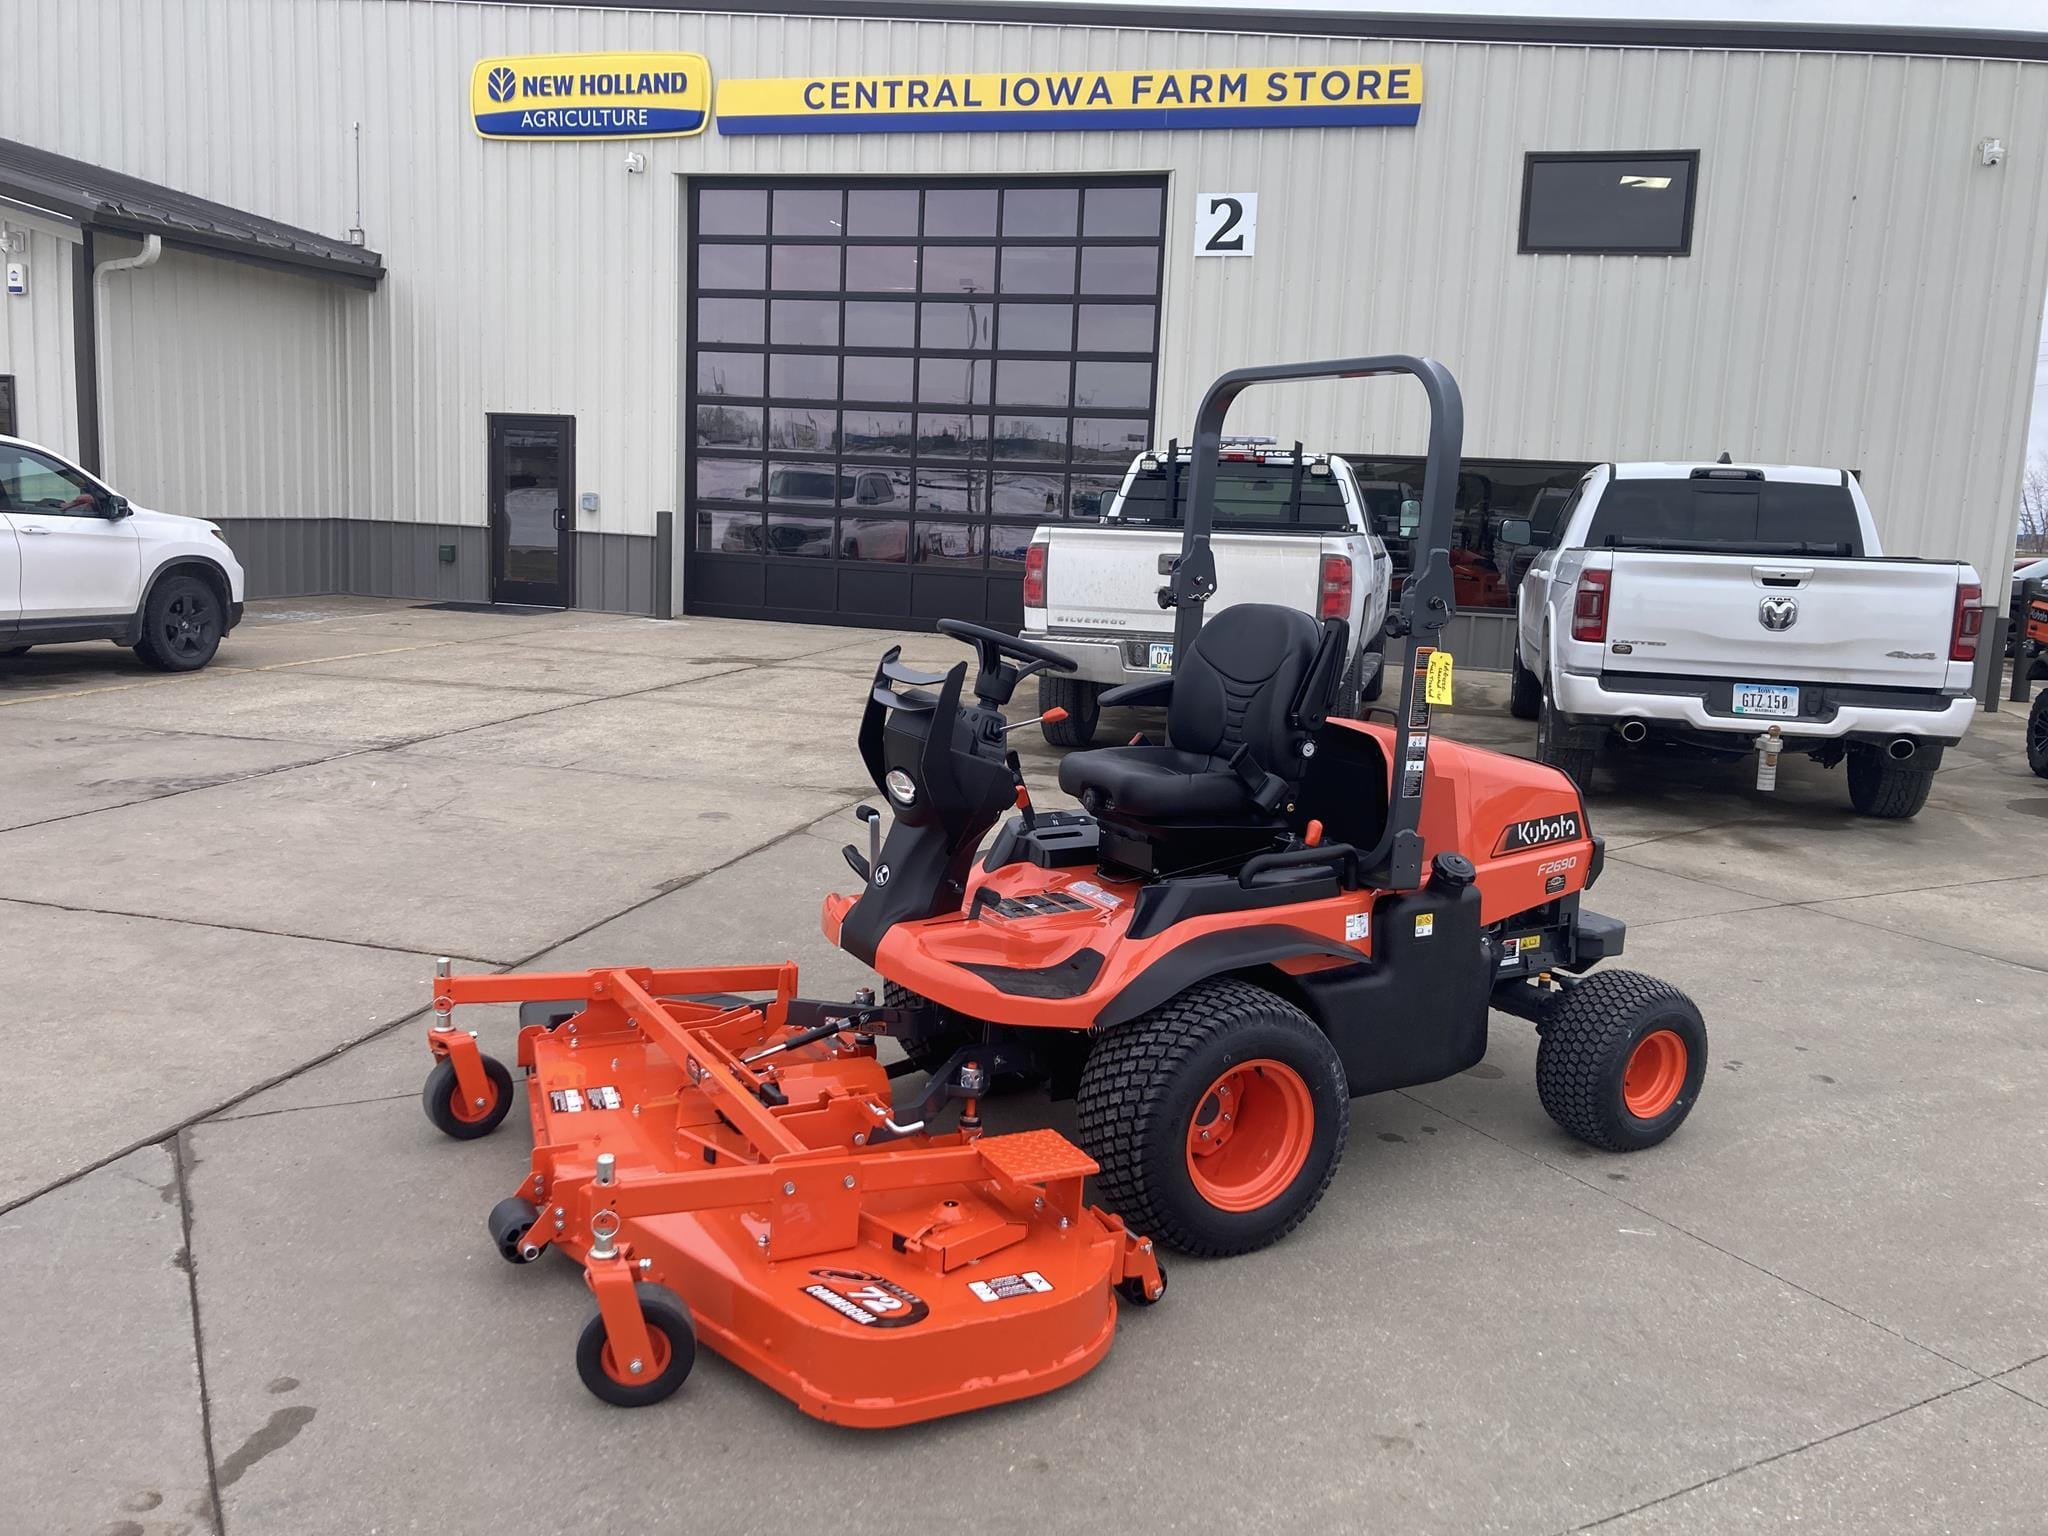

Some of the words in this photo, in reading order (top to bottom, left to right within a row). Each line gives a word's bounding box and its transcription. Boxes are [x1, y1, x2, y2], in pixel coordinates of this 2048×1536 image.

[522, 74, 574, 98] NEW
[579, 71, 688, 96] HOLLAND
[804, 79, 983, 110] CENTRAL
[999, 76, 1113, 106] IOWA
[1131, 73, 1248, 104] FARM
[1266, 69, 1412, 102] STORE
[521, 109, 649, 129] AGRICULTURE
[1204, 197, 1245, 251] 2
[1057, 616, 1127, 626] SILVERADO
[1742, 693, 1763, 708] GTZ
[1768, 694, 1788, 710] 150
[1517, 814, 1577, 845] Kubota
[1537, 856, 1577, 876] F2690
[805, 1284, 878, 1325] COMMERCIAL
[845, 1285, 904, 1313] 72
